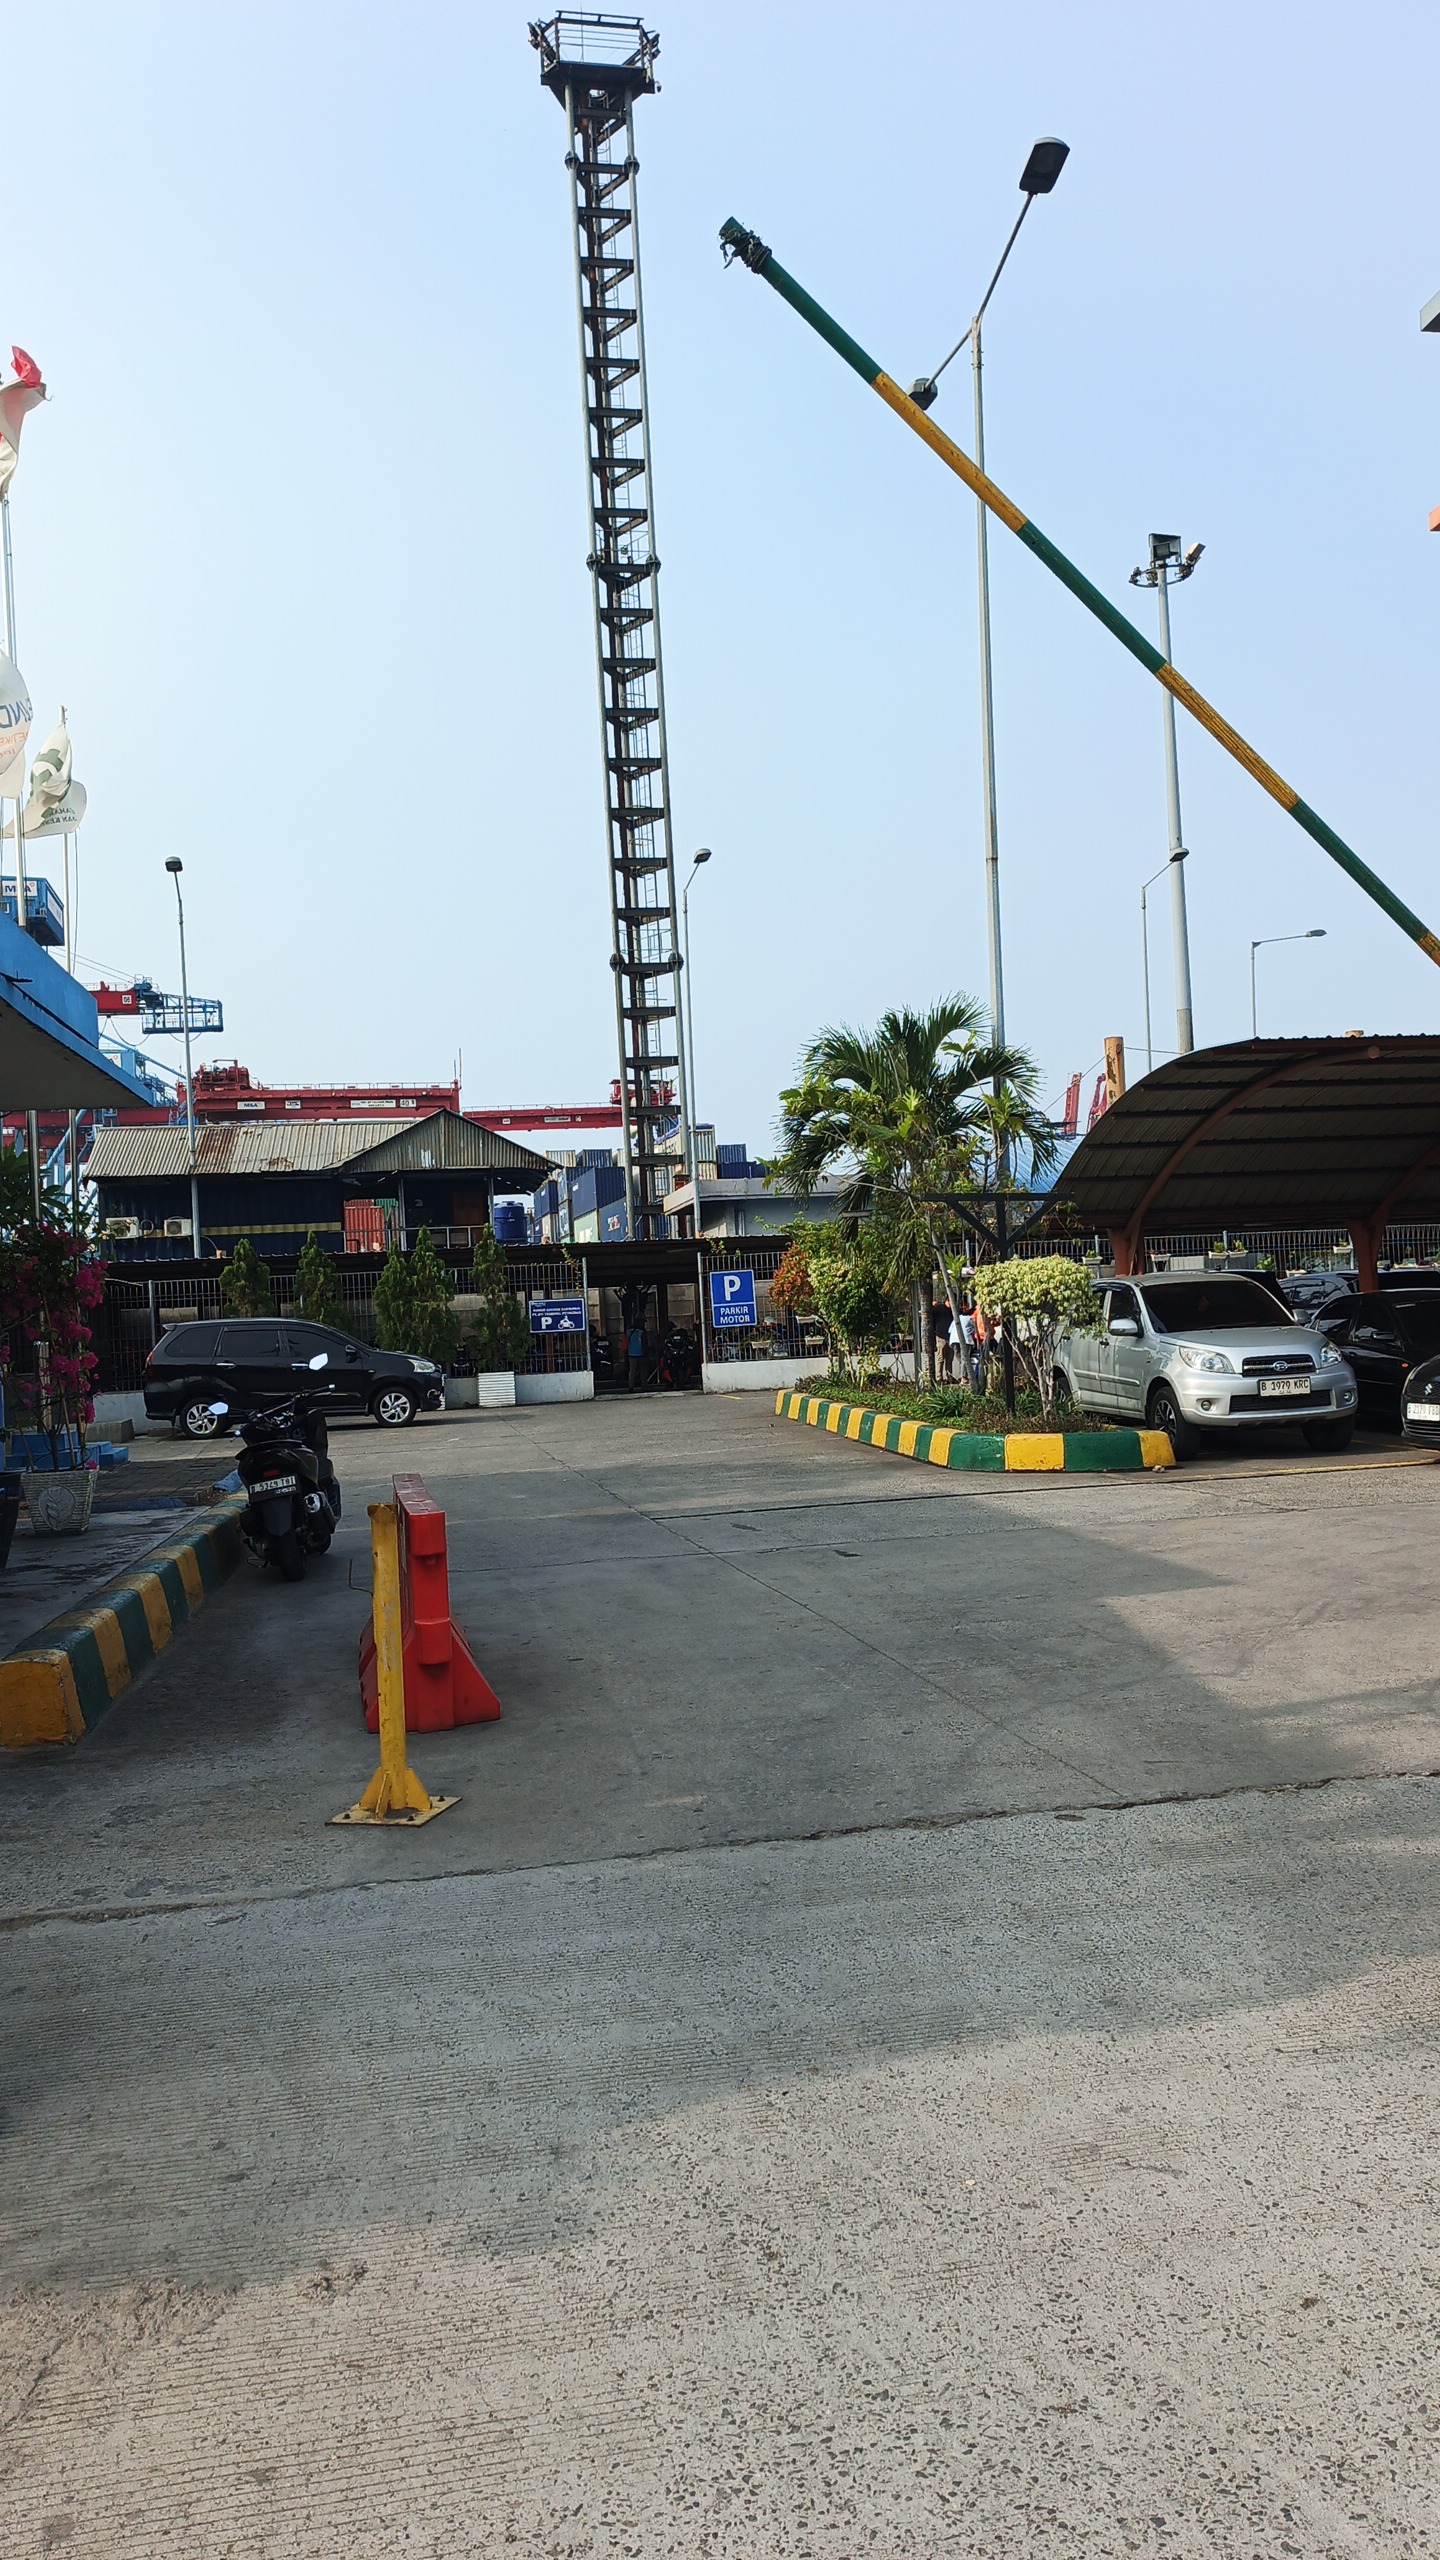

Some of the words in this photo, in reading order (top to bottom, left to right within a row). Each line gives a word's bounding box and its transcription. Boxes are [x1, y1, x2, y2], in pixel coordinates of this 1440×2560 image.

[5, 885, 32, 893] MA
[724, 1275, 741, 1301] P
[720, 1306, 749, 1315] PARKIR
[541, 1316, 553, 1330] P
[720, 1315, 750, 1324] MOTOR
[1261, 1381, 1267, 1391] B
[1271, 1380, 1291, 1391] 1979
[1293, 1379, 1309, 1390] KRC
